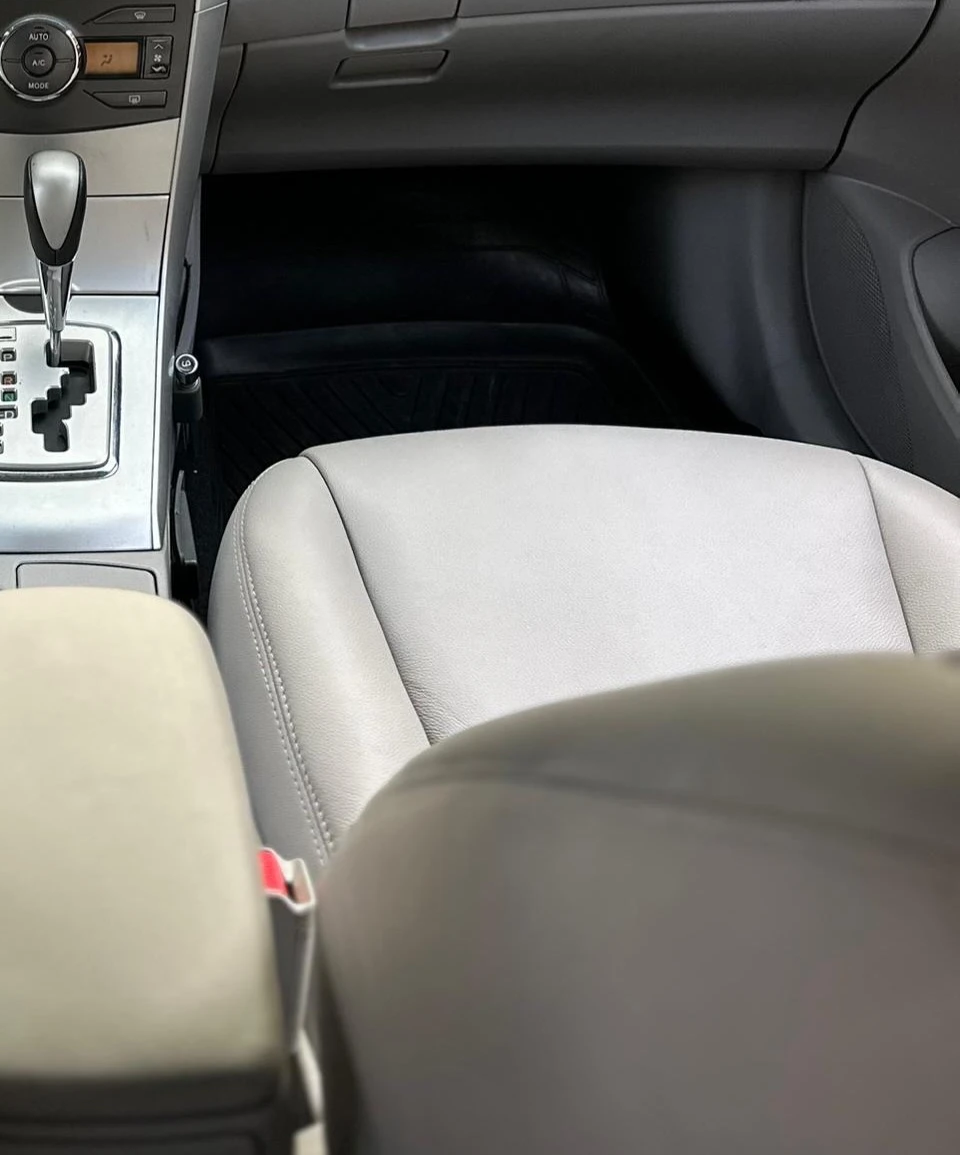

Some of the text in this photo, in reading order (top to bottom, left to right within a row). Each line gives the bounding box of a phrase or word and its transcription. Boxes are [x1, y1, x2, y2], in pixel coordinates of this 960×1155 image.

[29, 33, 49, 41] AUTO
[32, 59, 46, 67] A/C
[28, 82, 49, 90] MODE
[3, 353, 13, 361] P
